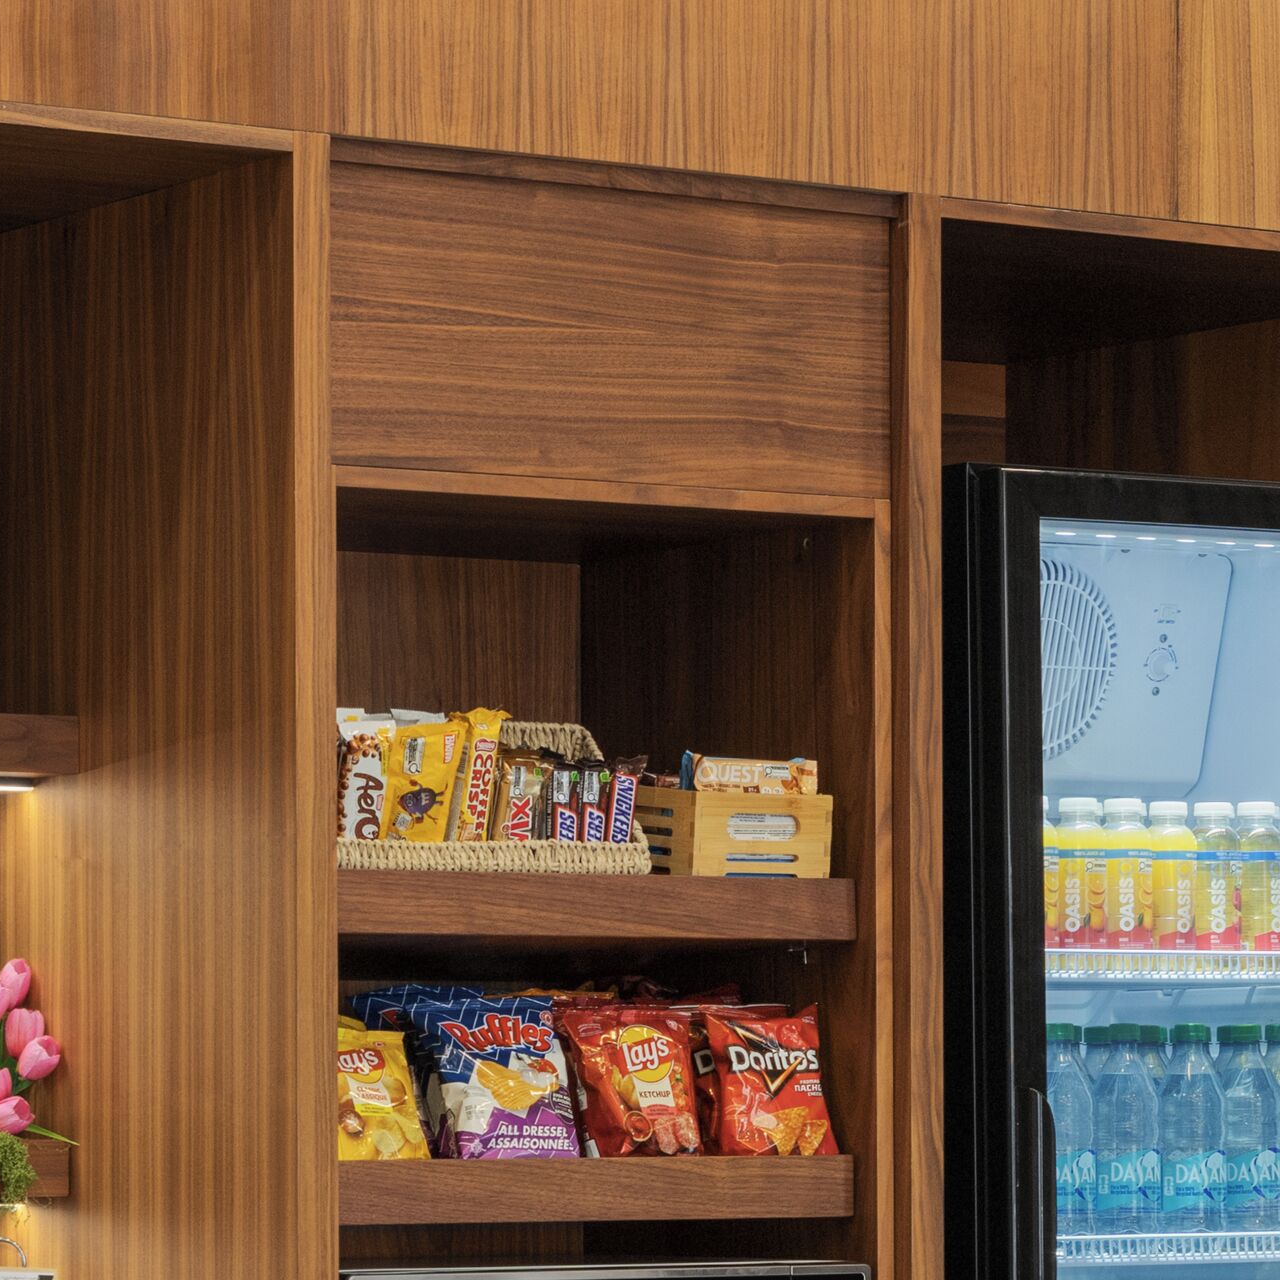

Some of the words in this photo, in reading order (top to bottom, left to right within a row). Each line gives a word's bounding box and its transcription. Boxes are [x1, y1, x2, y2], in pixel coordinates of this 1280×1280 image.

[467, 753, 484, 817] CRISP
[475, 753, 494, 832] COFFEE
[697, 761, 763, 784] QUEST
[353, 772, 384, 841] Aero
[610, 773, 635, 844] SNICKERS
[1064, 878, 1081, 933] OASIS
[1119, 877, 1135, 932] OASIS
[1176, 879, 1192, 934] OASIS
[1210, 878, 1227, 933] OASIS
[438, 1012, 556, 1053] Ruffles
[622, 1035, 670, 1072] Lay's
[727, 1046, 820, 1072] Doritos
[639, 1090, 672, 1099] KETCHUP
[497, 1124, 520, 1137] ALL
[1056, 1154, 1096, 1189] ASAN
[1110, 1154, 1161, 1189] DASAN
[1175, 1154, 1227, 1190] DASAN
